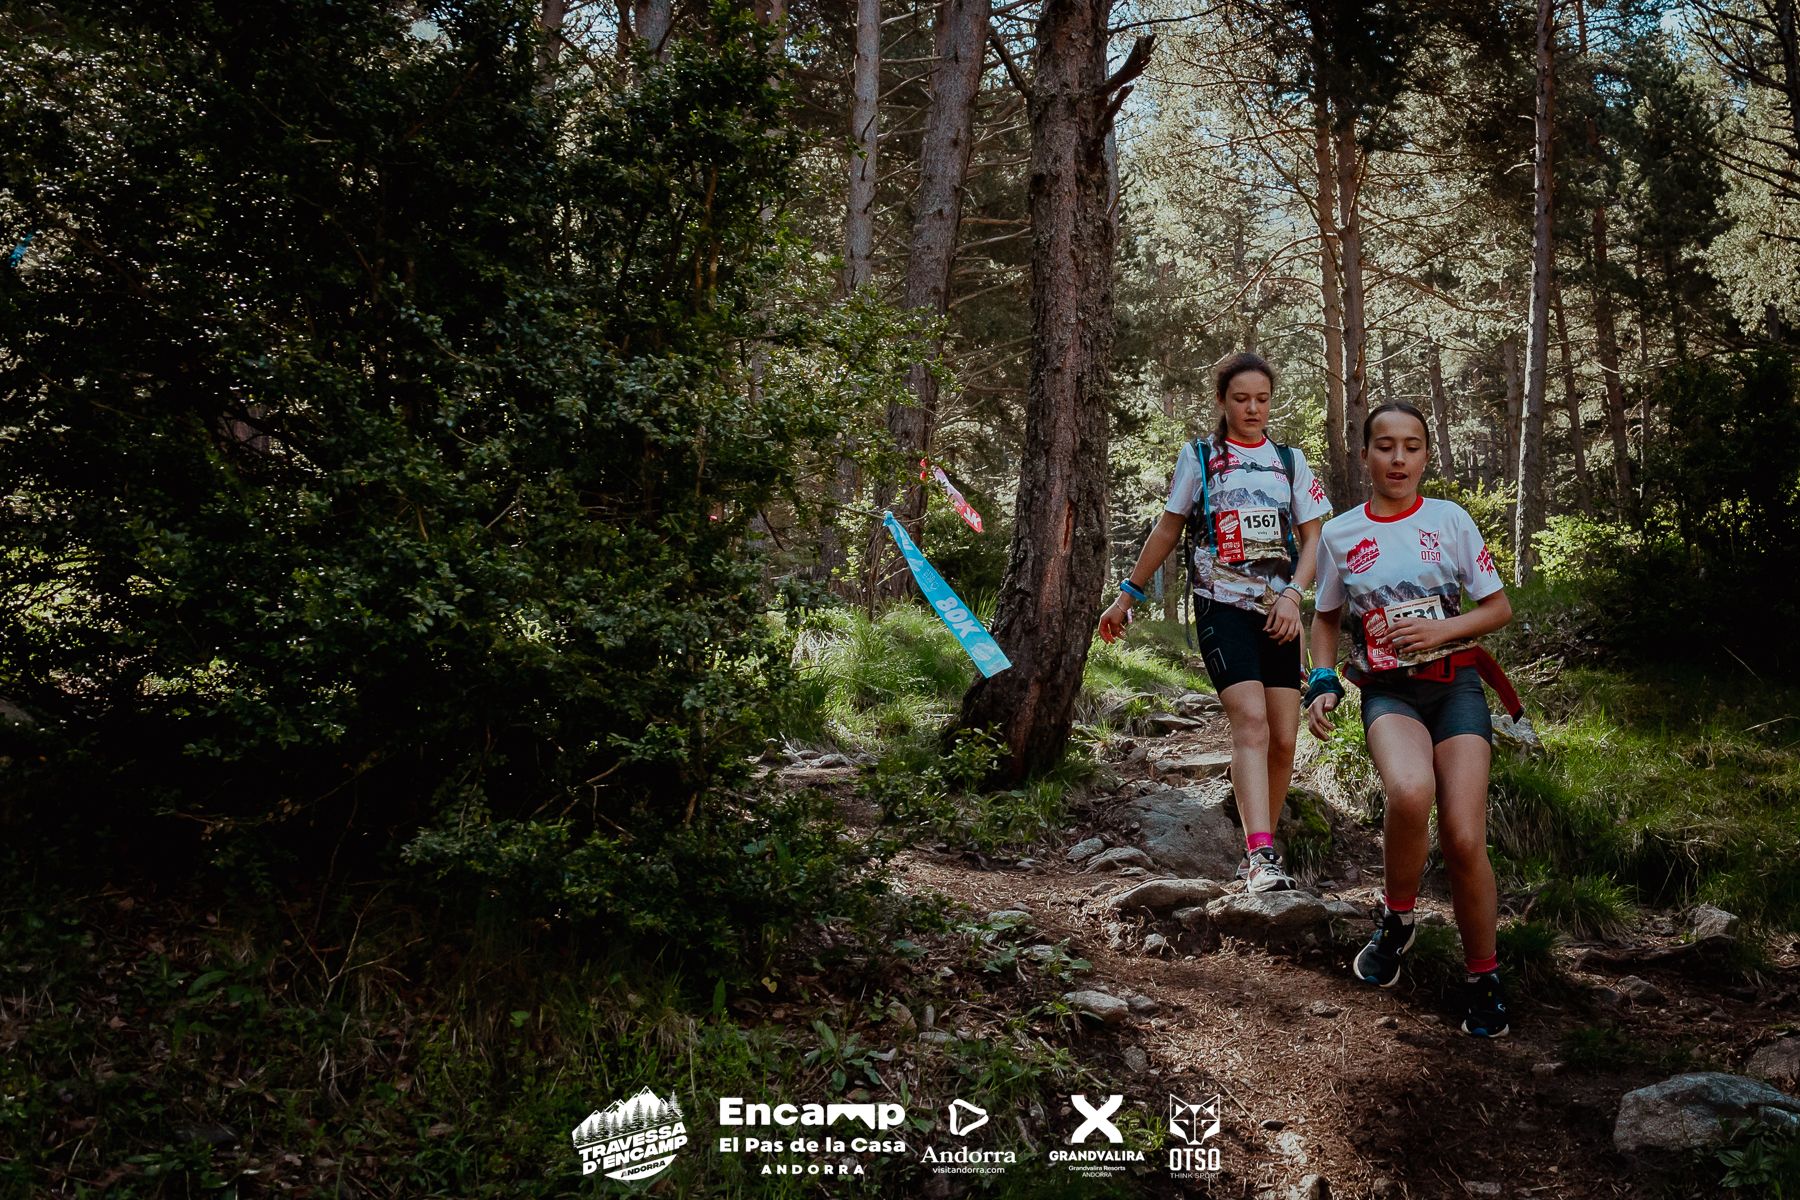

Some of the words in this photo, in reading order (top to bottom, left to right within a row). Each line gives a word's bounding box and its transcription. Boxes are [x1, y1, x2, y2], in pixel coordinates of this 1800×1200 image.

[1243, 514, 1277, 529] 1567
[1421, 550, 1441, 561] OTSO
[935, 596, 981, 639] 80K
[1394, 606, 1438, 620] 31
